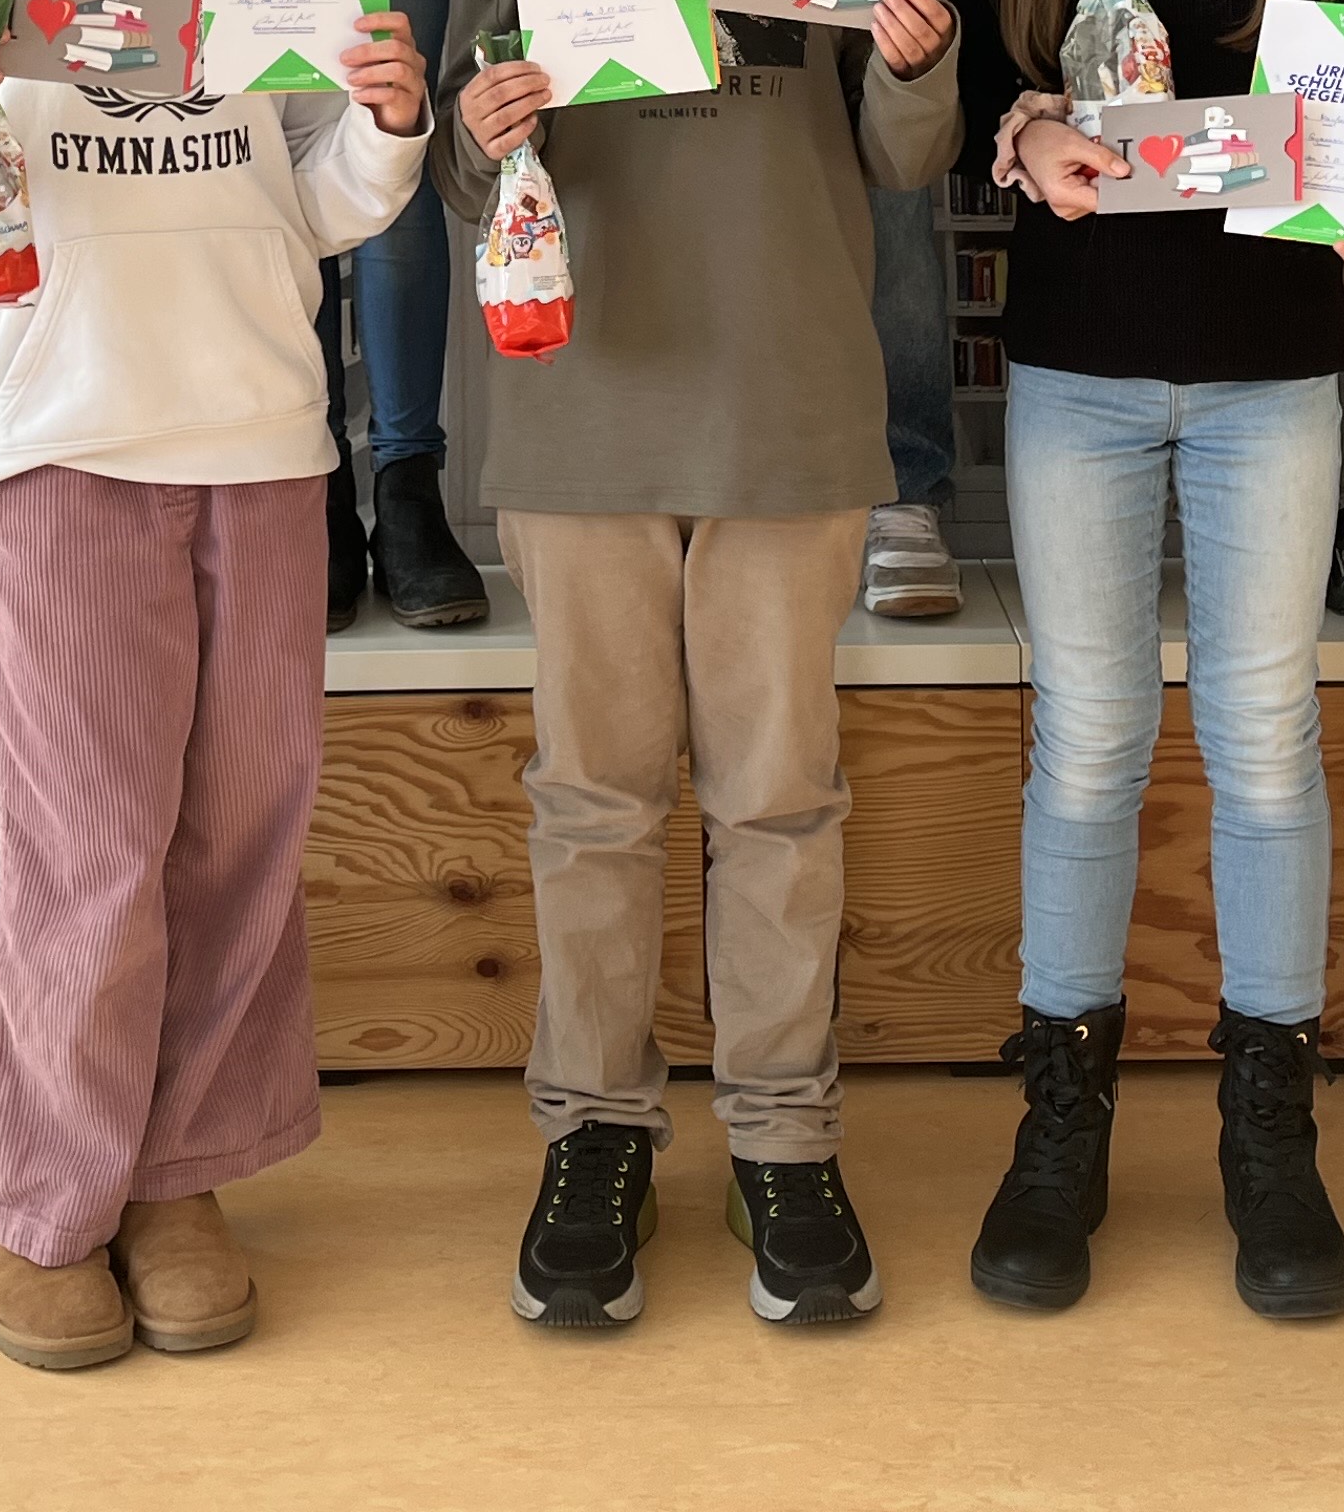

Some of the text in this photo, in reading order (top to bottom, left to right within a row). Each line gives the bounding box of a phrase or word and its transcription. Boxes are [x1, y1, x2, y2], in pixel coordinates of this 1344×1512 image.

[1287, 74, 1342, 91] SCHUL
[639, 108, 718, 119] UNLIMITED
[51, 125, 252, 175] GYMNASIUM
